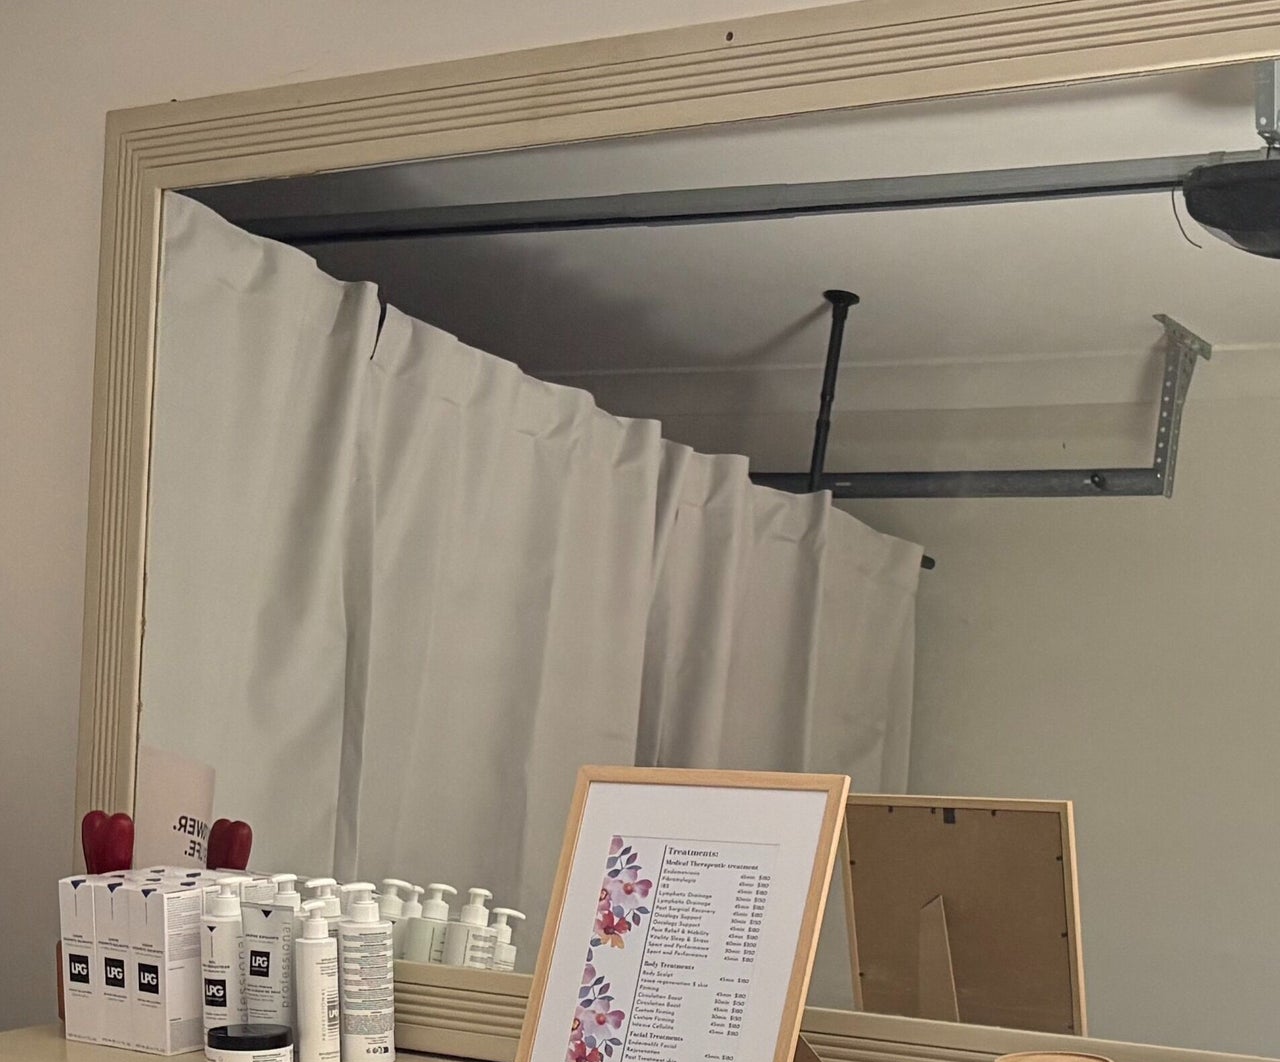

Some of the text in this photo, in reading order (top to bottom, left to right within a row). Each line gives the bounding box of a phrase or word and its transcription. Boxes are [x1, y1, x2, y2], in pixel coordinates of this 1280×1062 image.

[252, 956, 267, 967] LPG
[280, 922, 291, 1008] professional
[71, 962, 87, 975] LPG
[107, 966, 122, 979] LPG
[141, 972, 157, 985] LPG
[207, 985, 224, 996] LPG
